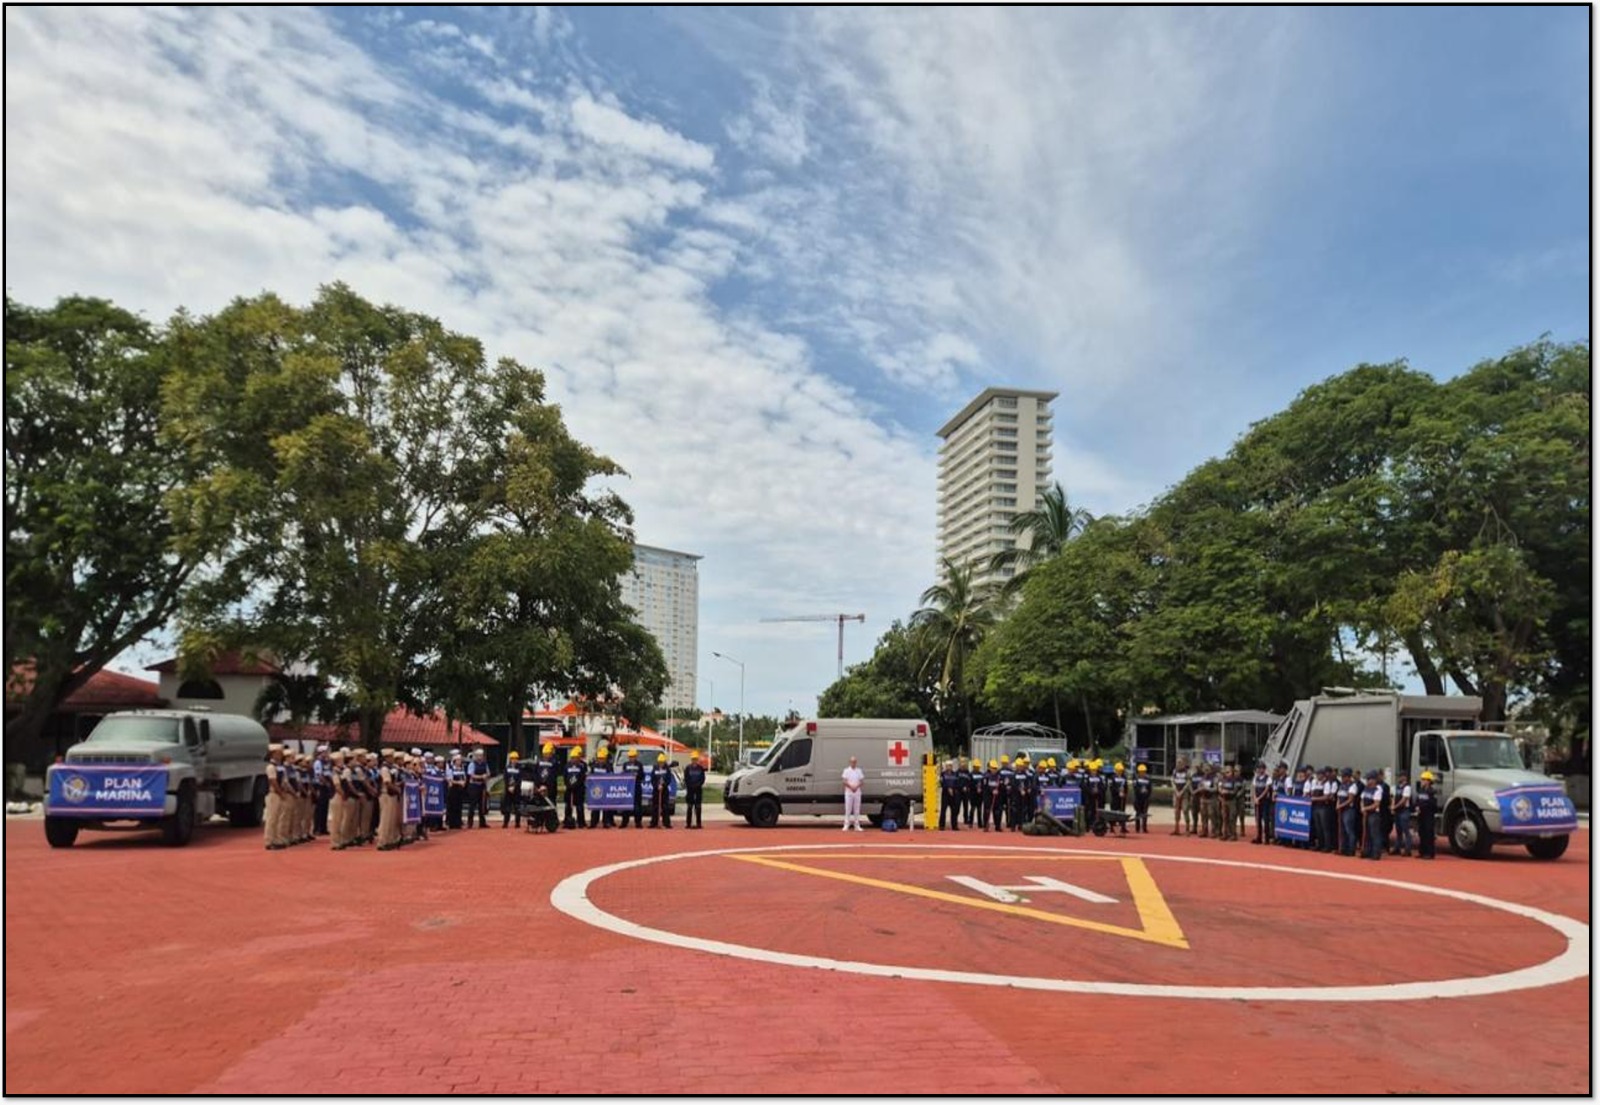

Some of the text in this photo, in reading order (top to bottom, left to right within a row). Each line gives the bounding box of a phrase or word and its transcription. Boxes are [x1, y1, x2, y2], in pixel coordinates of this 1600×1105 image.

[104, 778, 142, 788] PLAN
[95, 790, 152, 801] MARINA
[1541, 797, 1565, 806] PLAN
[1537, 808, 1571, 818] MARINA
[944, 875, 1120, 903] H
